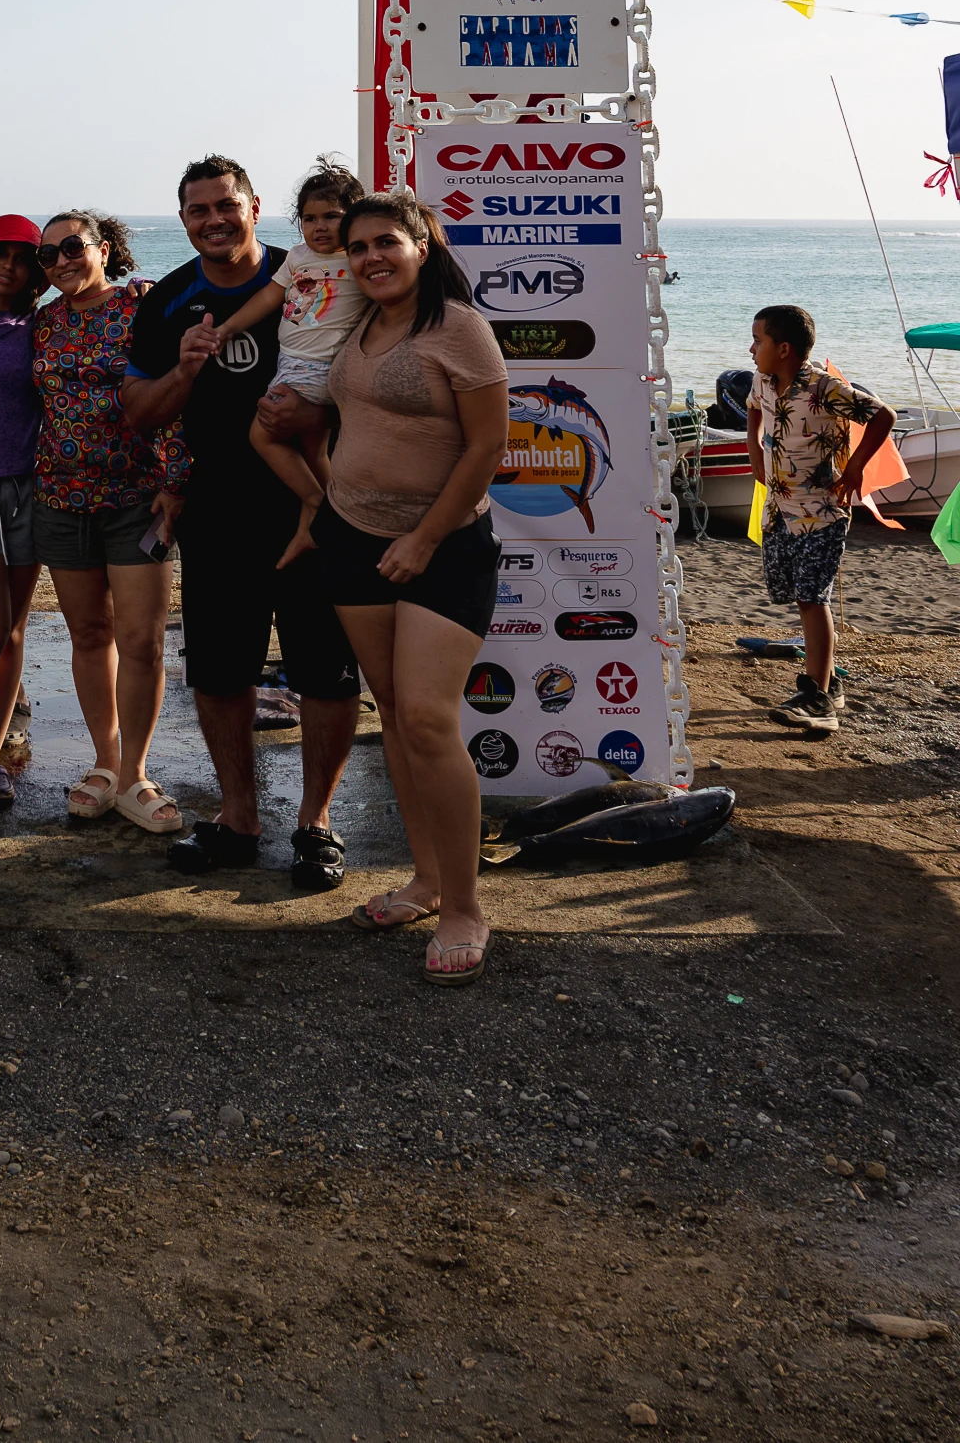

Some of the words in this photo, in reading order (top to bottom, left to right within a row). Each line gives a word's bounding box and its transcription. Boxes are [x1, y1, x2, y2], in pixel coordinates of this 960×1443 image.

[460, 16, 578, 36] CAPTURAS
[460, 39, 579, 67] PANAMÁ
[436, 142, 626, 172] CALVO
[443, 174, 624, 187] @rotuloscalvopanama
[482, 194, 621, 217] SUZUKI
[482, 225, 580, 244] MARINE
[480, 270, 584, 295] PMS
[511, 329, 558, 342] H&H
[227, 339, 253, 364] 10
[507, 438, 529, 449] esca
[502, 444, 581, 468] ambutal
[560, 469, 580, 477] pesca
[559, 547, 618, 563] Pesqueros
[590, 562, 618, 574] Sport
[601, 589, 622, 598] R&S
[489, 621, 542, 634] curate
[564, 628, 598, 636] FULL
[600, 627, 634, 636] AUTO
[598, 706, 641, 715] TEXACO
[604, 748, 637, 759] delta
